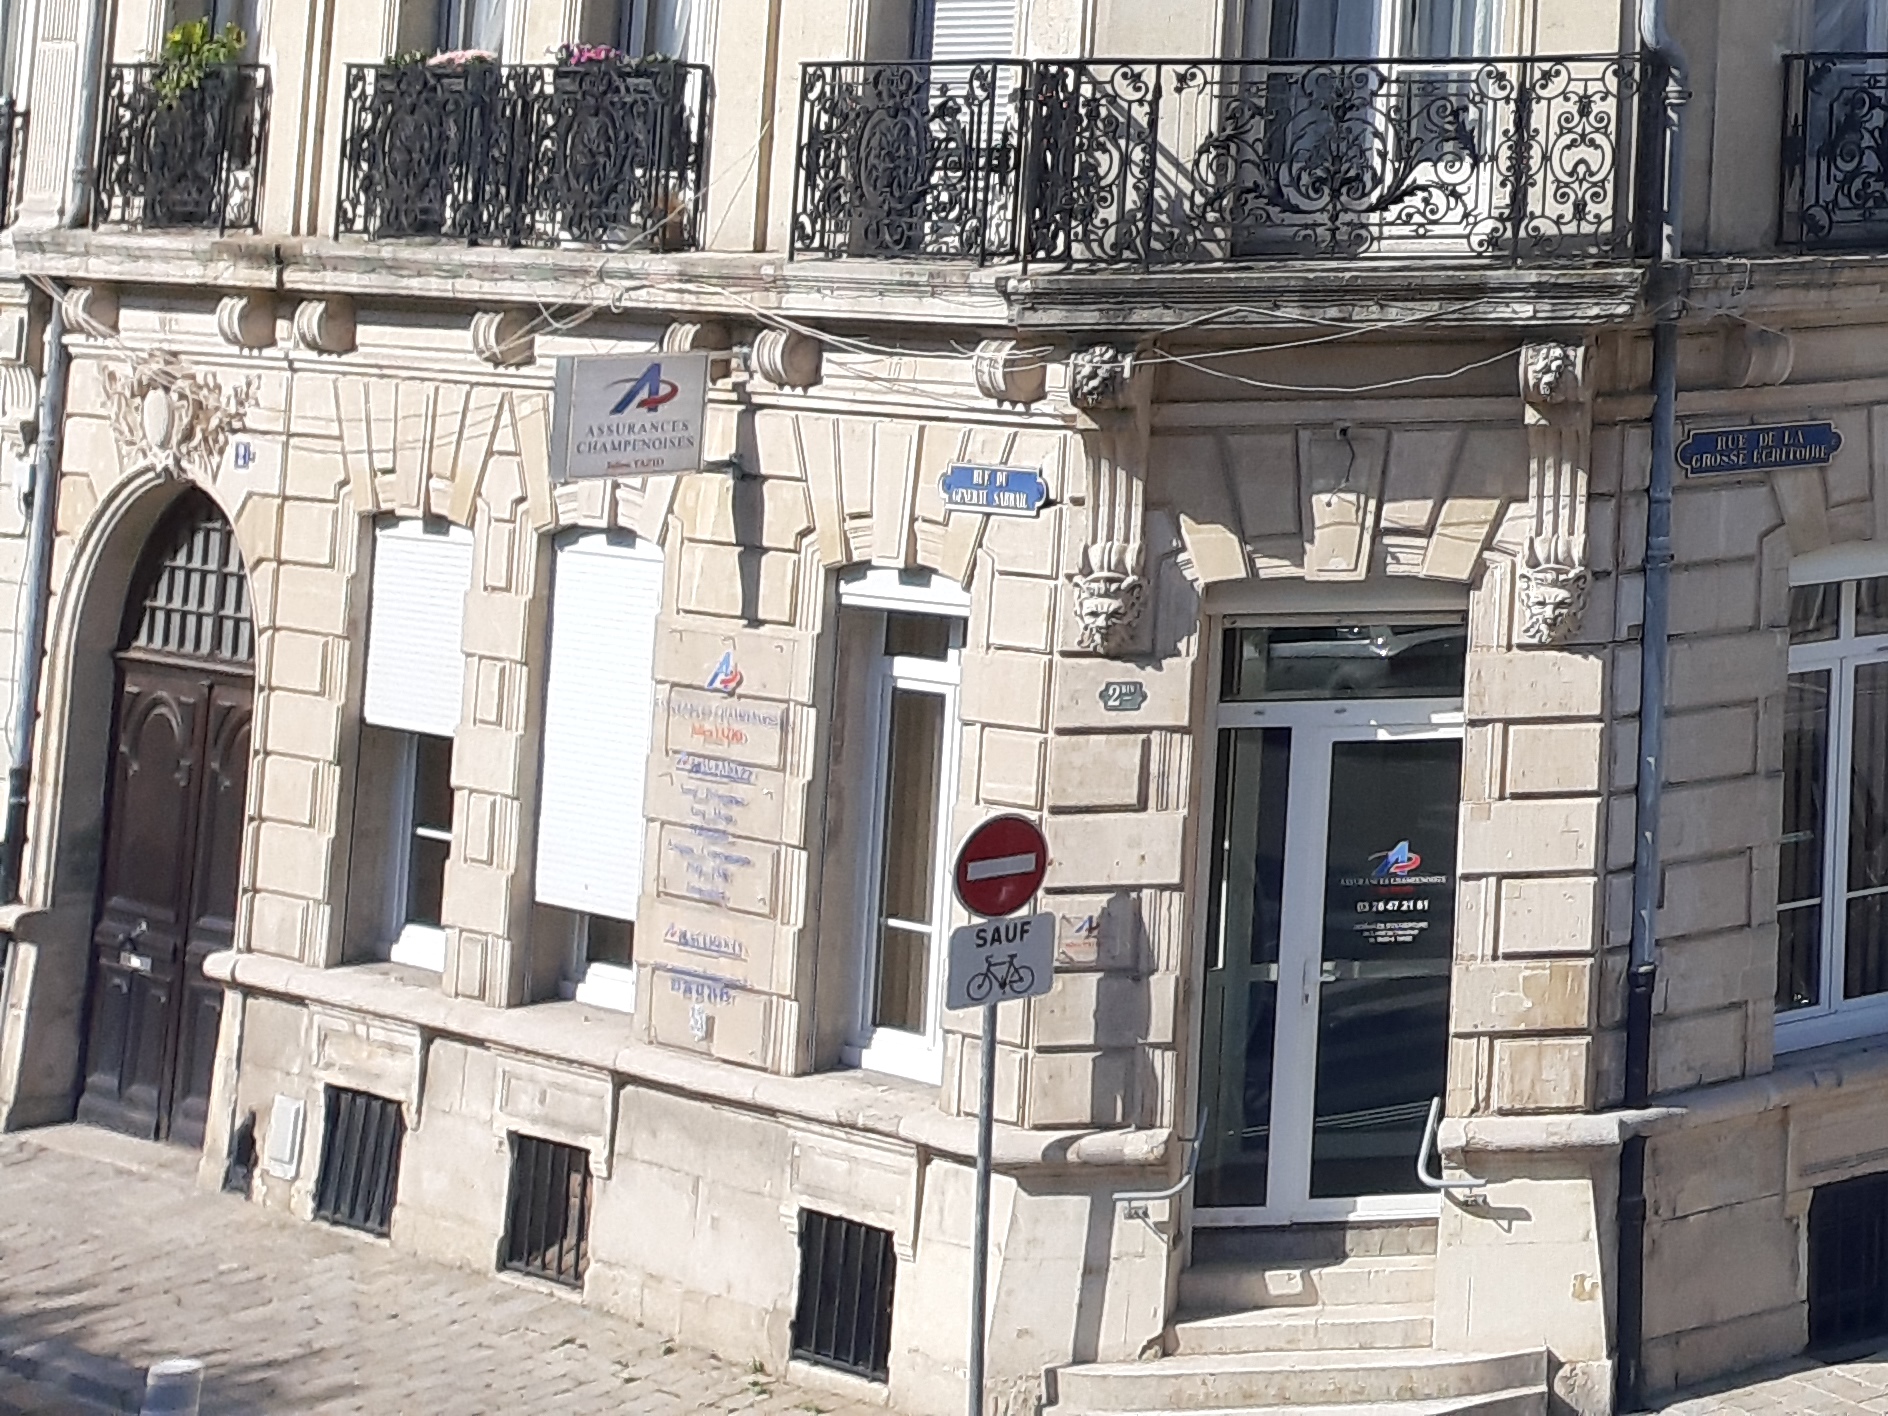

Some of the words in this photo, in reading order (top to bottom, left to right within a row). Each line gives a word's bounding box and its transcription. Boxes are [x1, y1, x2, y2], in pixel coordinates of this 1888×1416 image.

[586, 420, 690, 438] ASSURANCES
[576, 435, 695, 455] CHAMPENOISES
[1716, 433, 1747, 451] RUE
[1759, 431, 1776, 447] DE
[1783, 429, 1804, 445] LA
[1691, 450, 1748, 468] GROSSE
[996, 471, 1007, 488] DU
[974, 920, 1032, 949] SAUF
